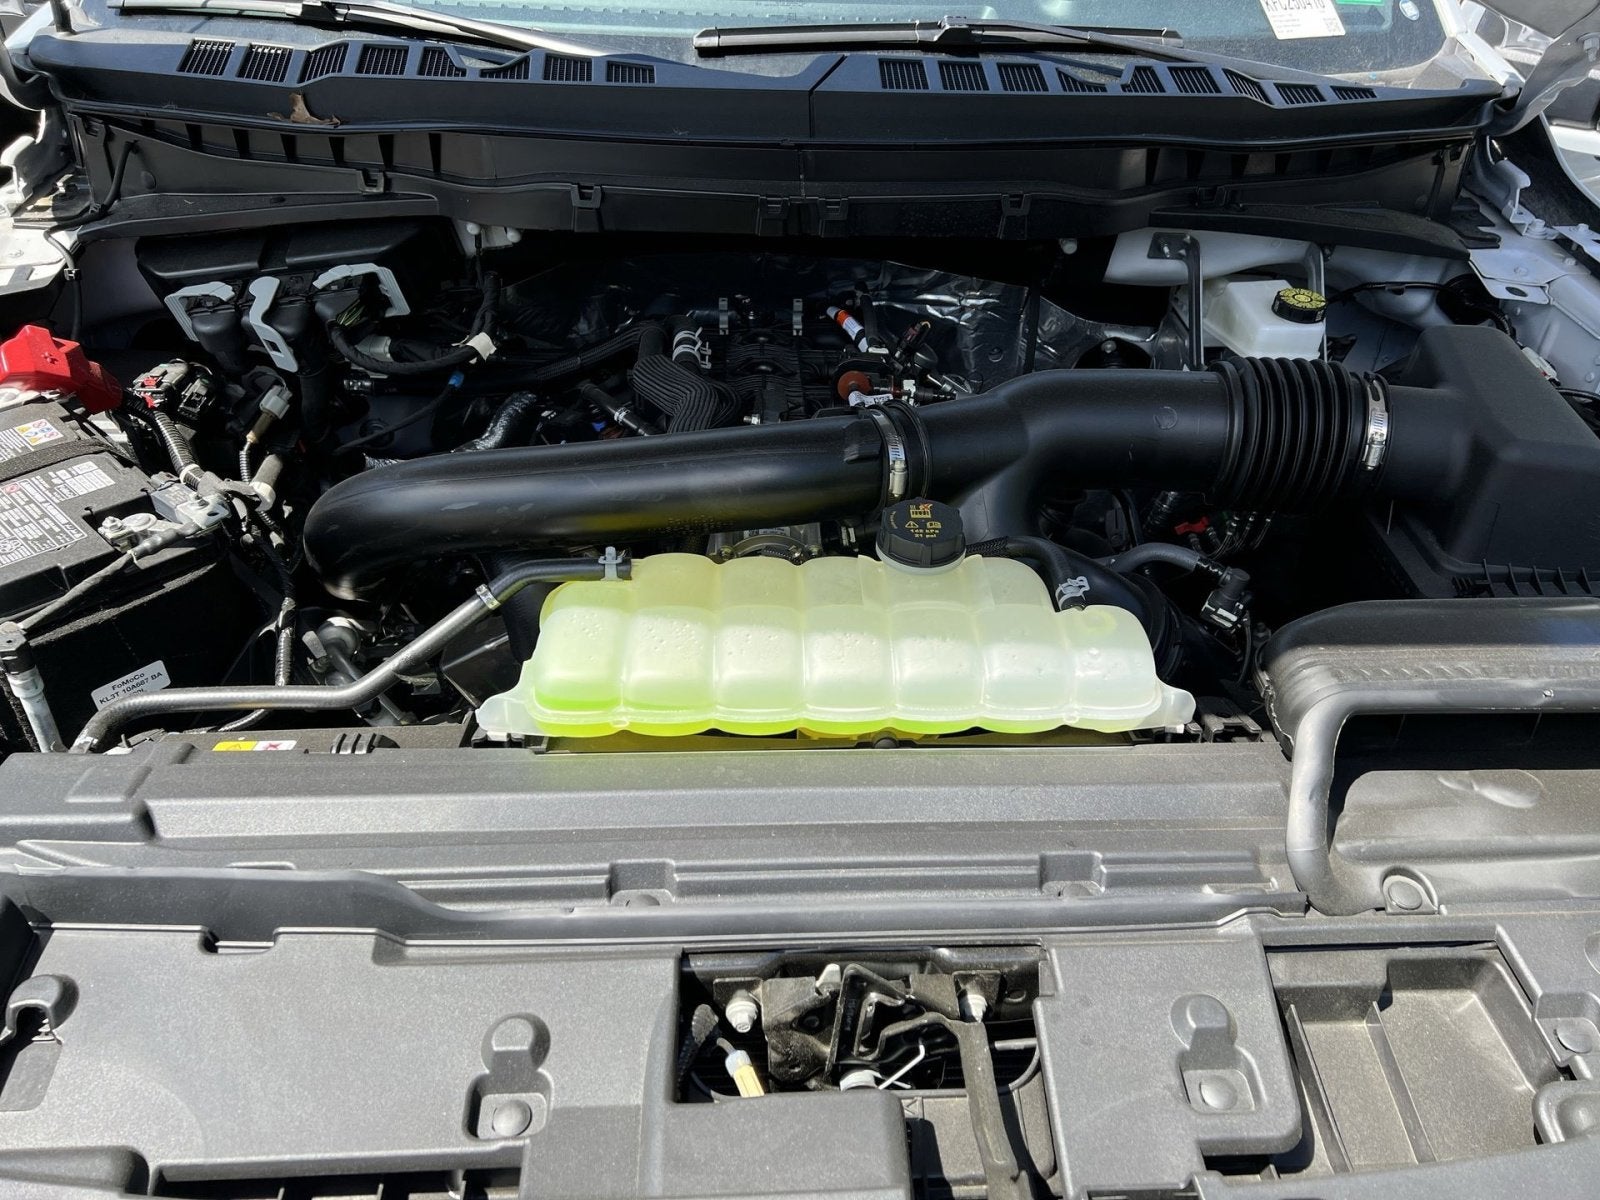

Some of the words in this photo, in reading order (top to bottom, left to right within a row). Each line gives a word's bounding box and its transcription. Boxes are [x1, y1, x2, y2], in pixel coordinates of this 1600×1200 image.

[99, 691, 120, 704] KL3T
[150, 671, 163, 681] BA
[111, 672, 145, 691] FoMoCo
